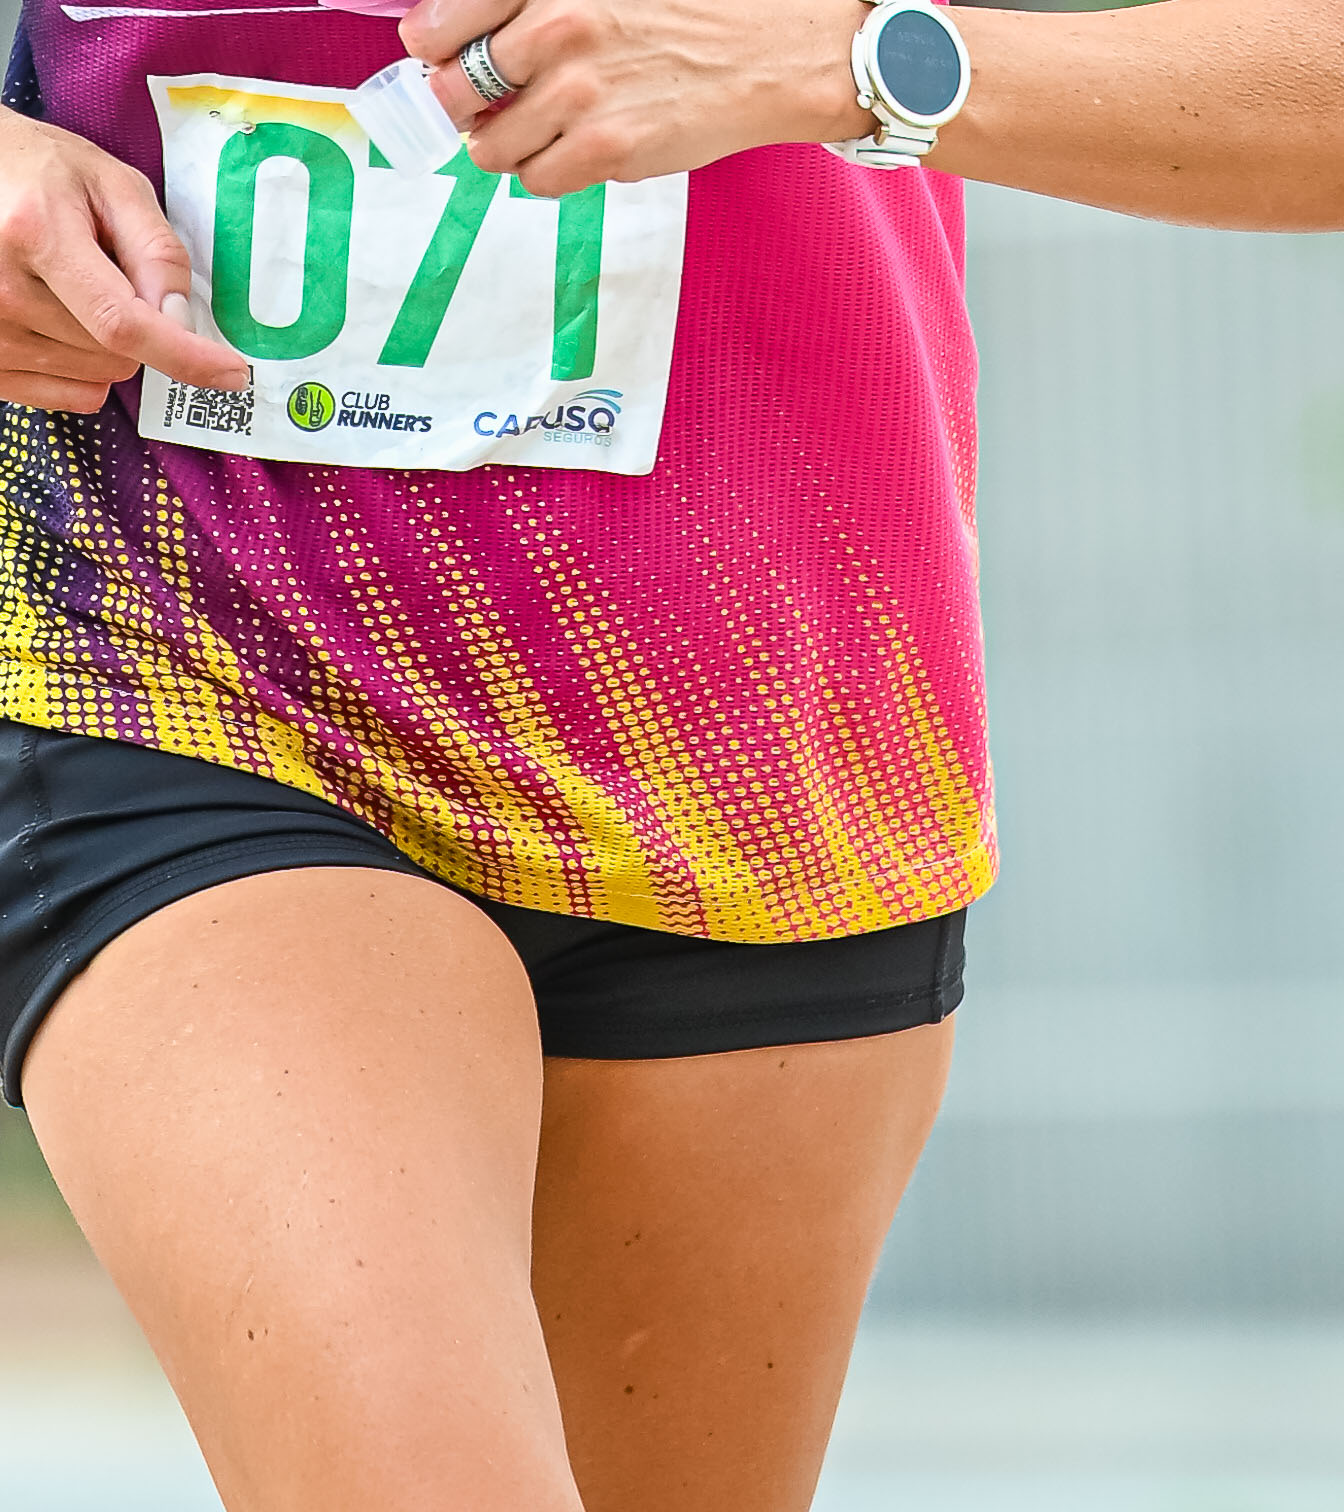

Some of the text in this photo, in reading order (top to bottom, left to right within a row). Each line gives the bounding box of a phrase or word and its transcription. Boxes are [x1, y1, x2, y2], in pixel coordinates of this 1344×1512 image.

[210, 121, 607, 381] 071
[340, 390, 391, 410] CLUB
[336, 410, 433, 434] RUNNER'S
[543, 430, 613, 447] SEGUROS
